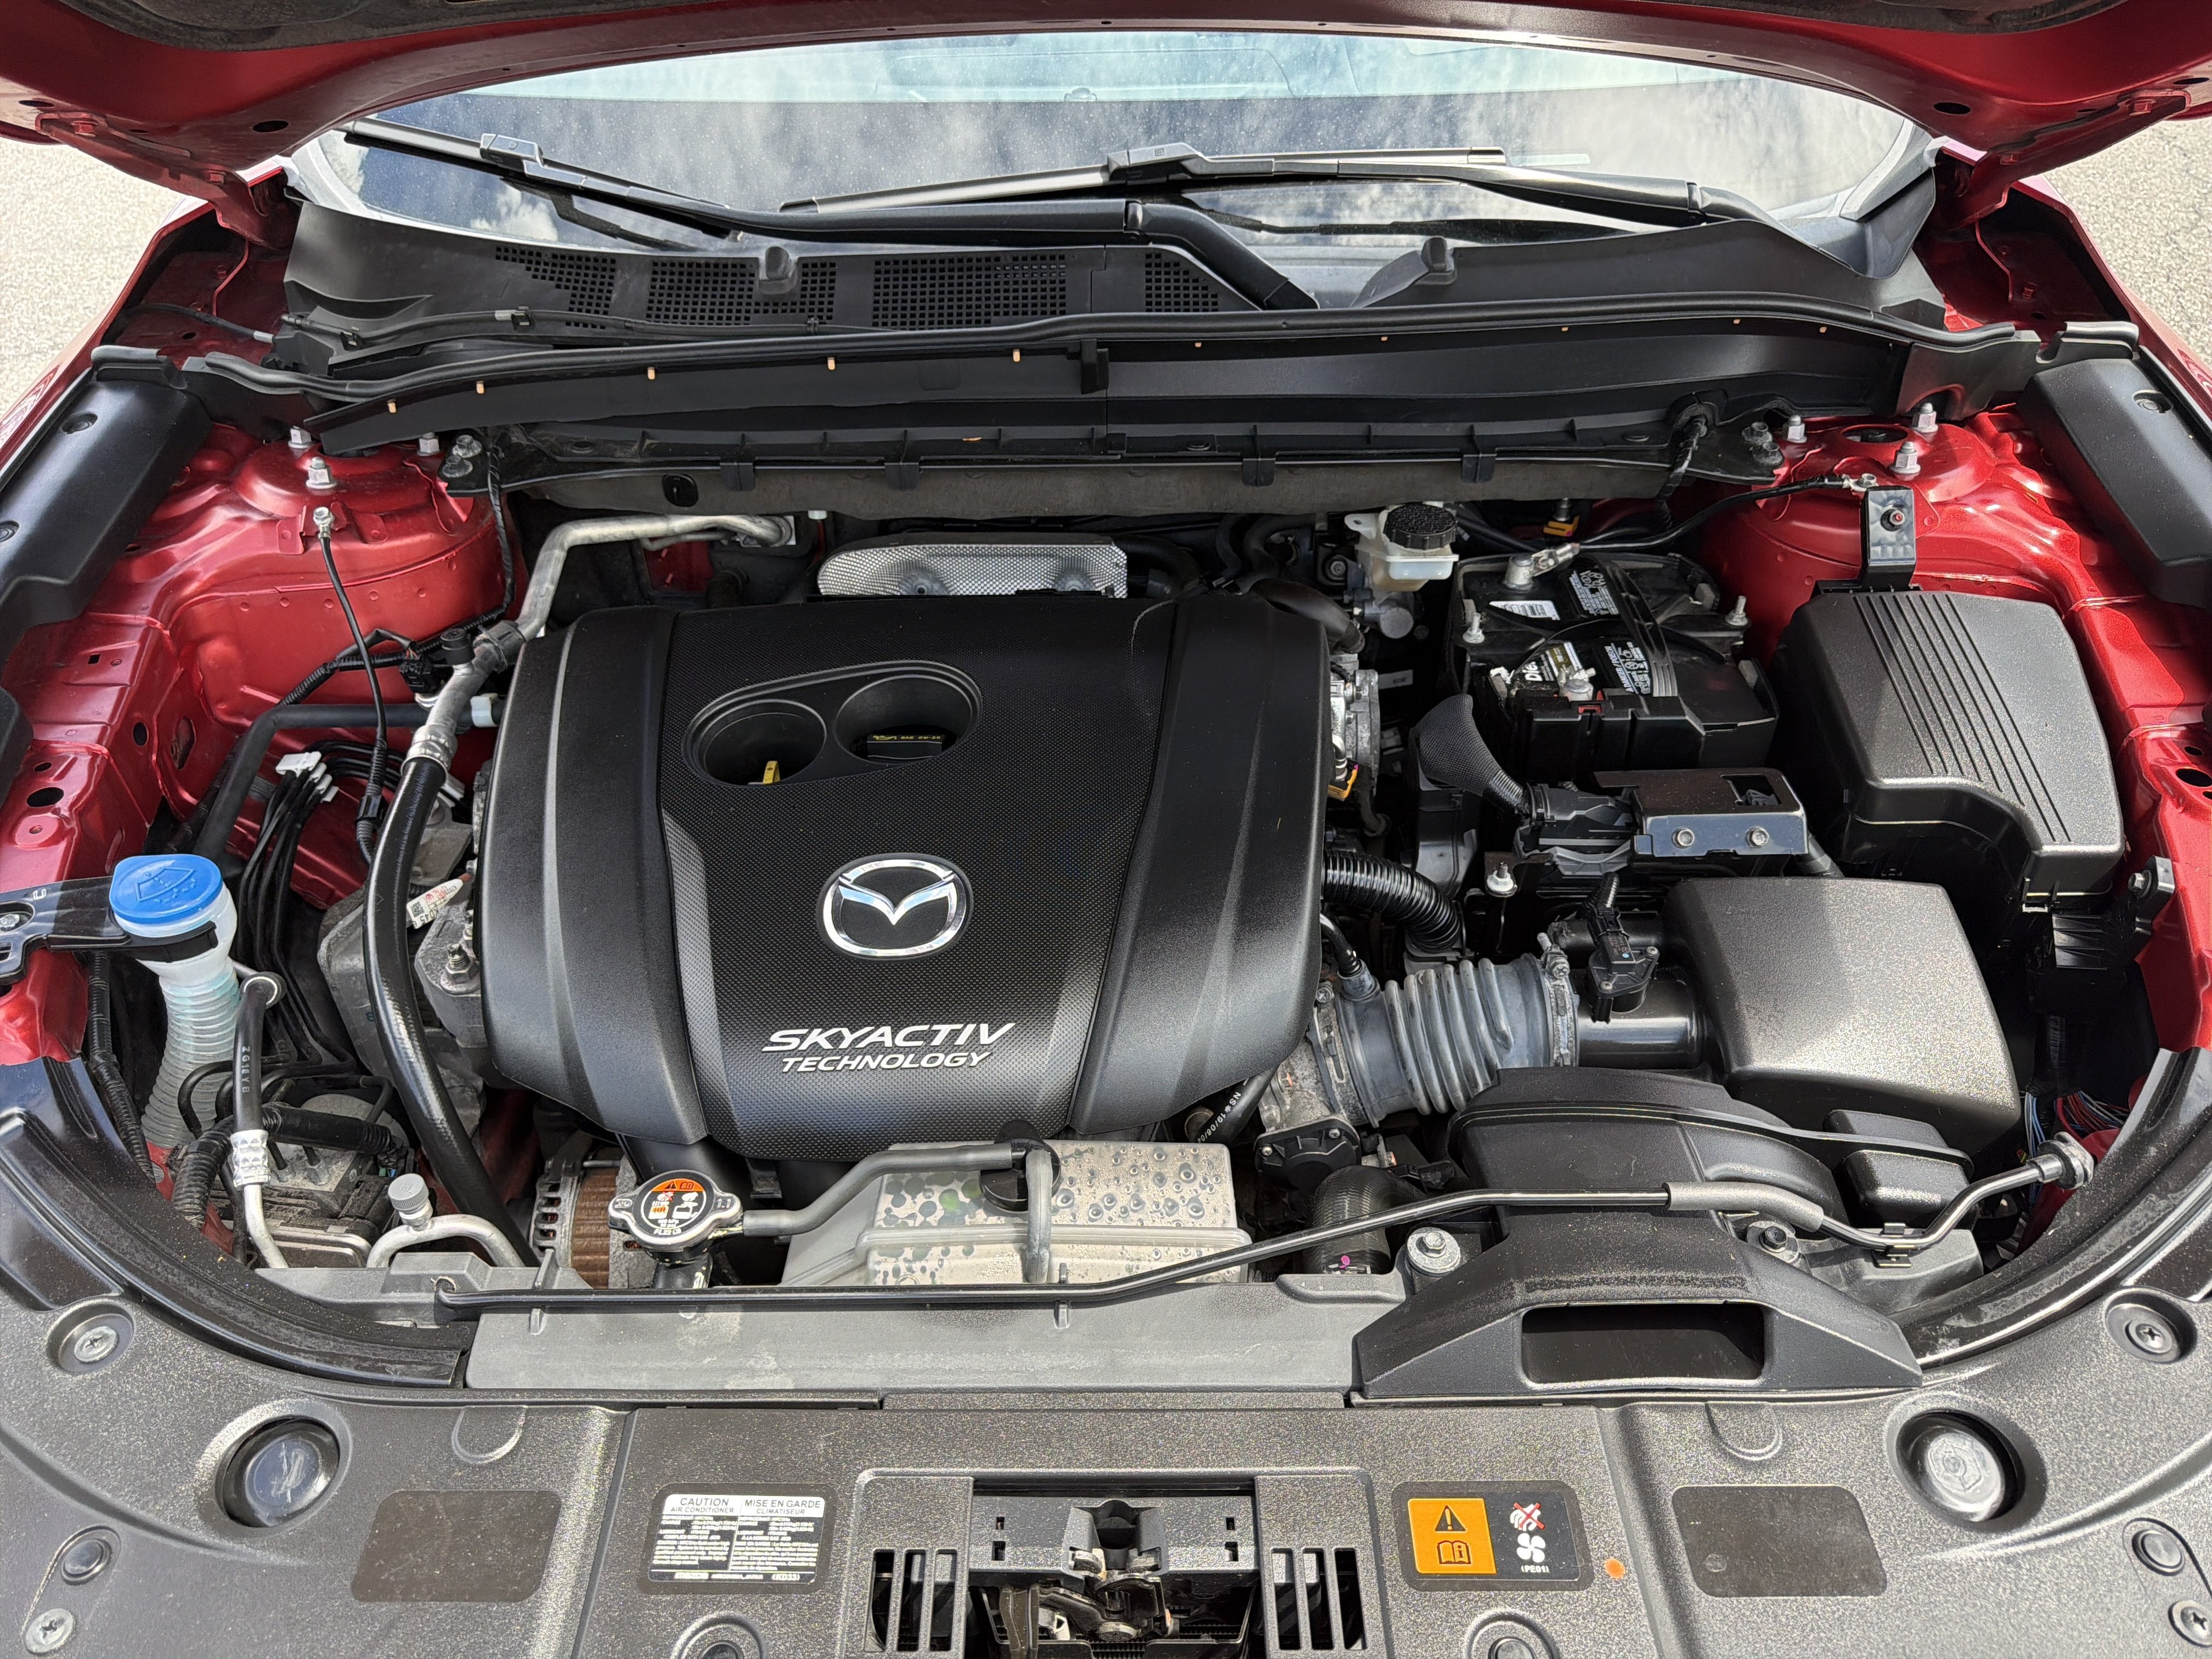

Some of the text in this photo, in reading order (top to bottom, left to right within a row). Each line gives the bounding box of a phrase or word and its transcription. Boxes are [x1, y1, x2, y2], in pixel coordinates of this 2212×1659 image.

[1604, 646, 1621, 663] POISON
[1522, 661, 1543, 681] Die
[1615, 667, 1632, 688] DANGER
[761, 1023, 1017, 1052] SKYACTIV
[782, 1052, 991, 1073] TECHNOLOGY
[717, 1198, 731, 1208] 1.1
[680, 1498, 729, 1506] CAUTION
[787, 1500, 821, 1508] GARDE
